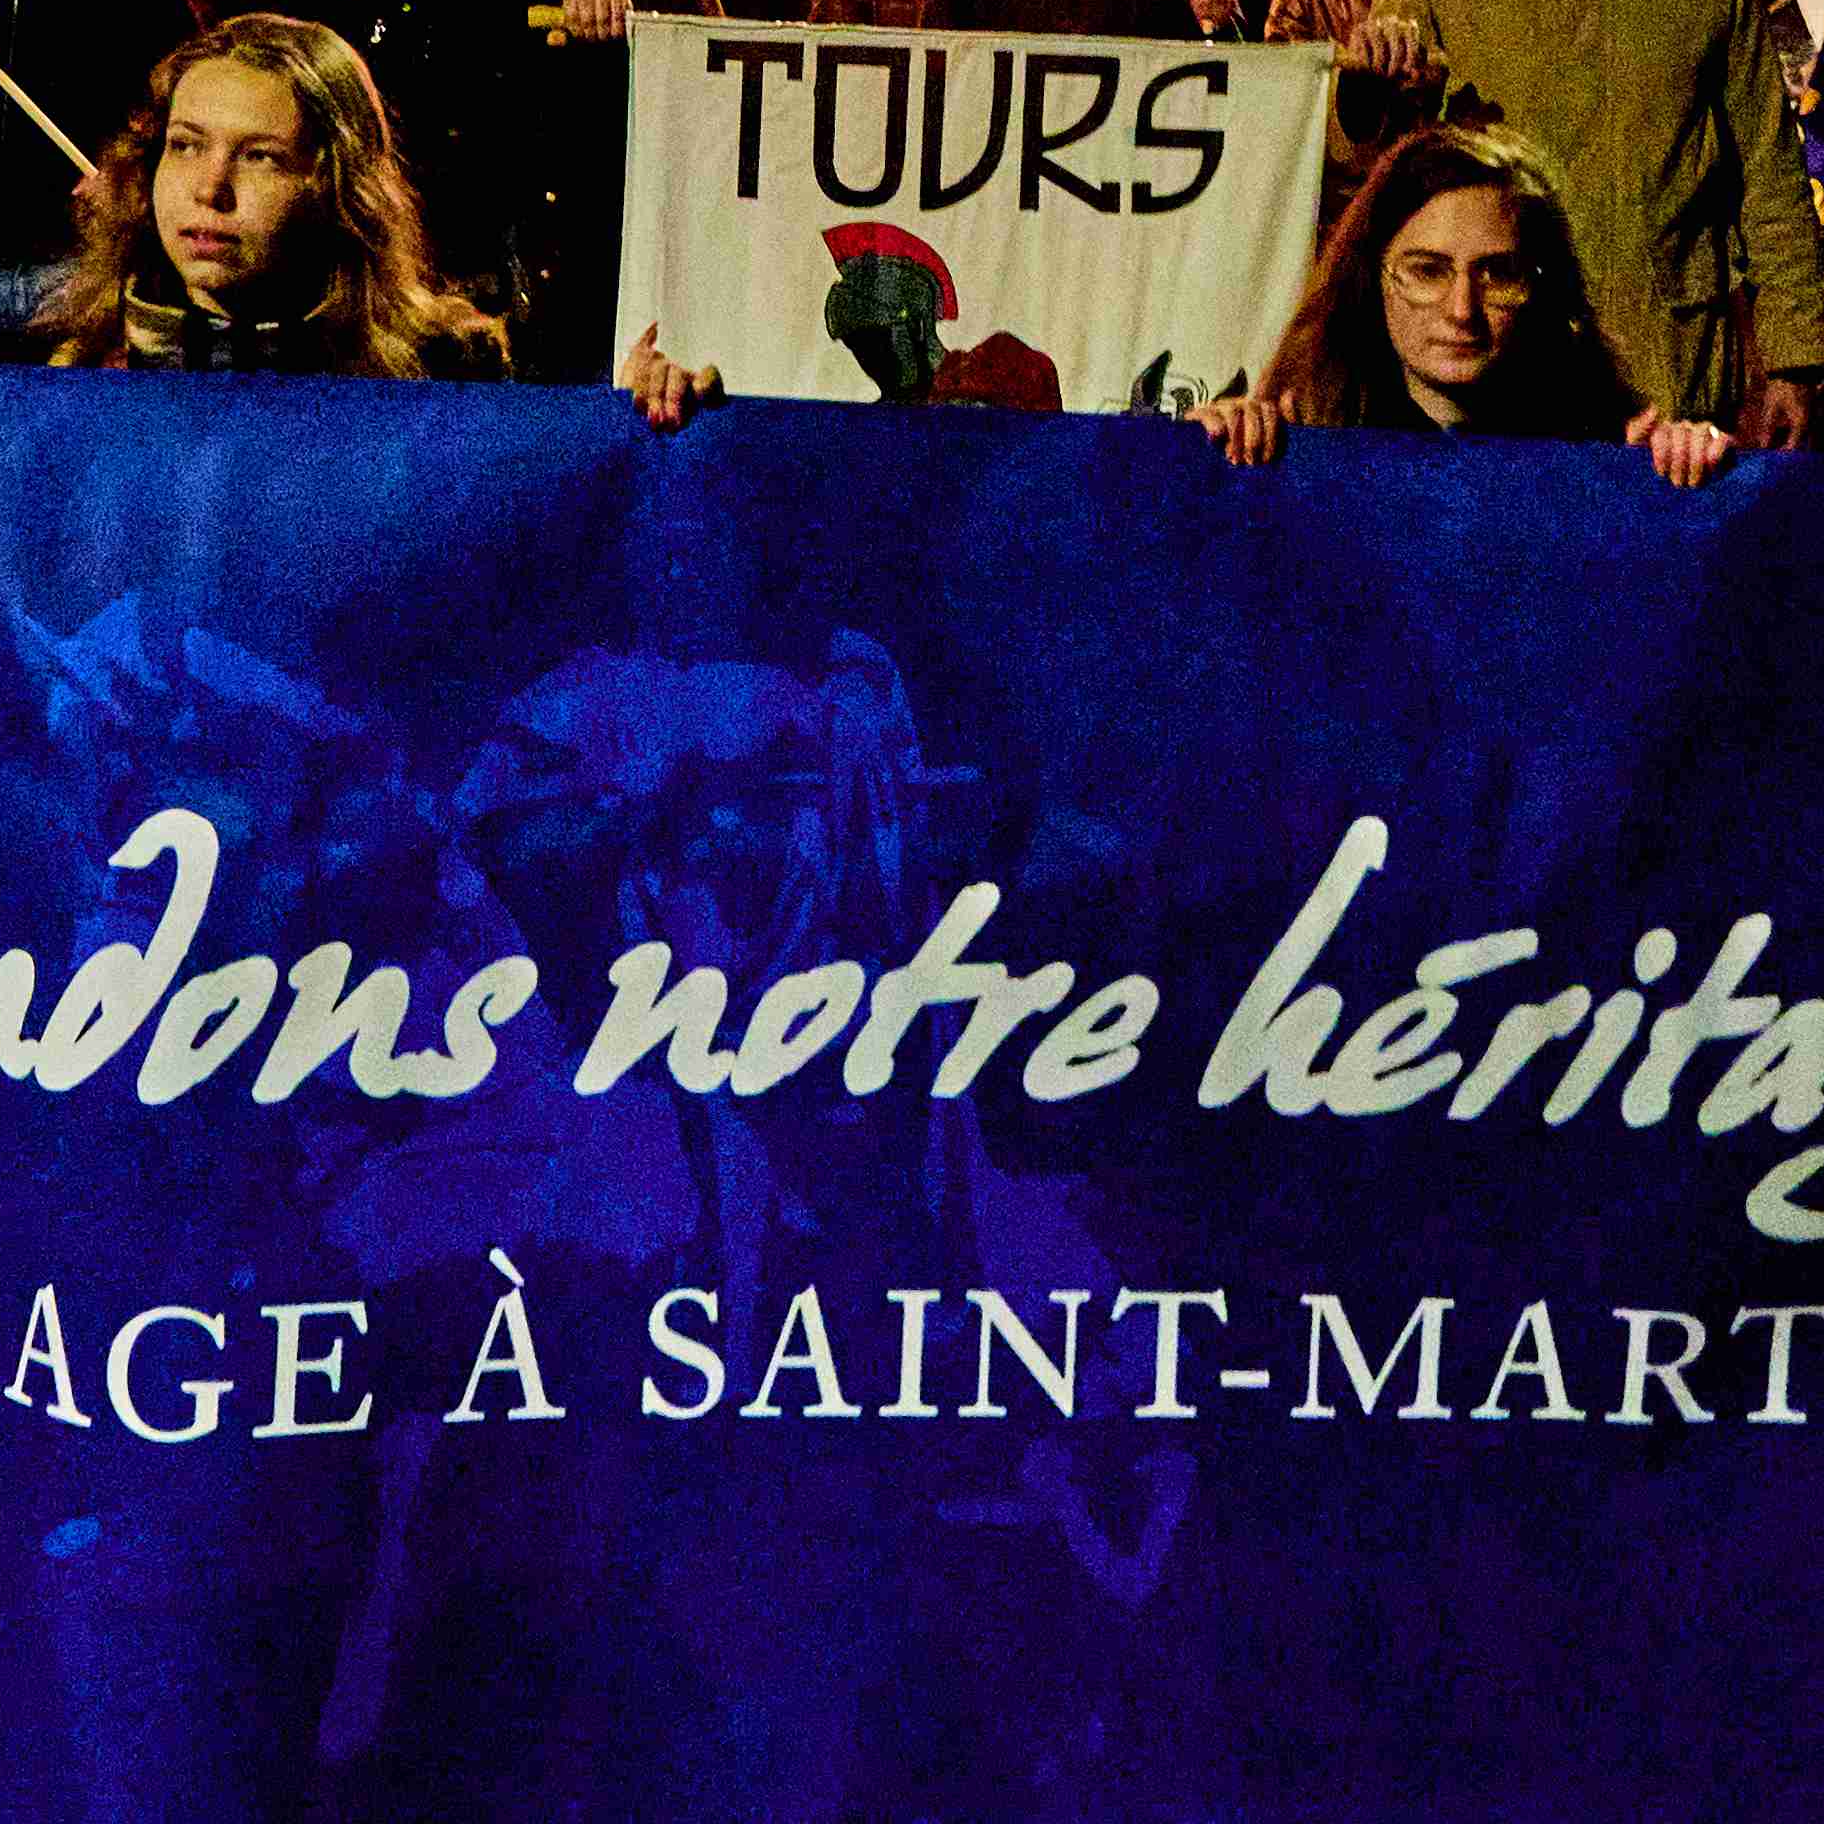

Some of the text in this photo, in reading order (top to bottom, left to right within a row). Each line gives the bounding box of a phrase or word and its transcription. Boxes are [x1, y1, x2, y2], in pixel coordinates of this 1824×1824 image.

[706, 38, 1229, 215] TOURS
[572, 881, 1160, 1102] notre
[443, 1246, 566, 1423] À
